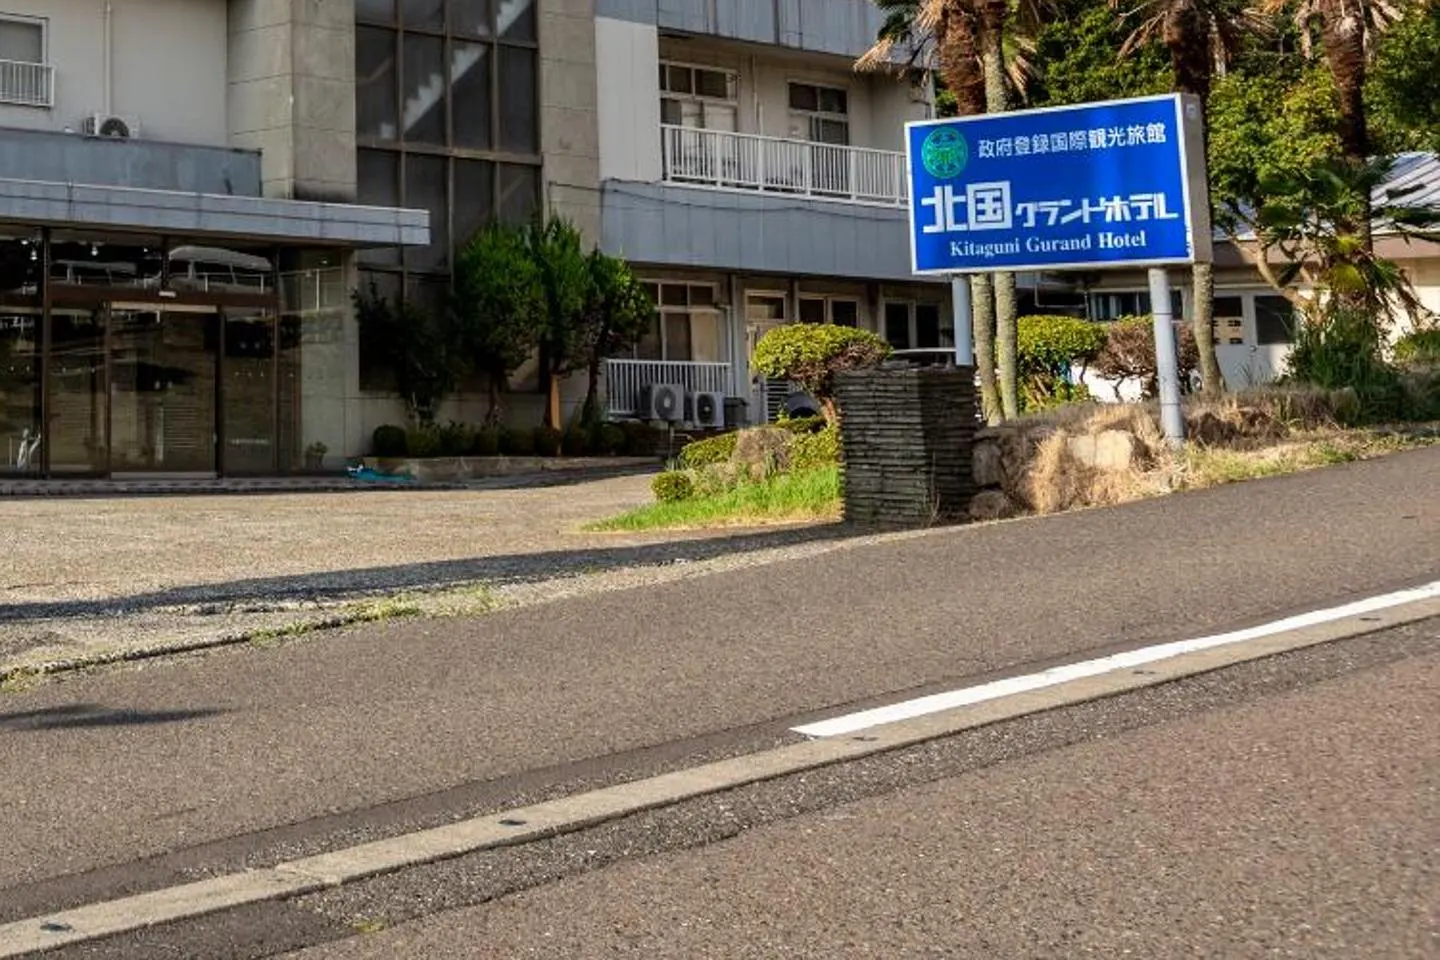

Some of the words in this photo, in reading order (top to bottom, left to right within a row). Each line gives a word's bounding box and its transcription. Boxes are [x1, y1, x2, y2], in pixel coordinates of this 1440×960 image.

[978, 122, 1166, 158] 政府登録国際観光旅館
[921, 181, 1178, 233] 北国グランドホテル
[950, 238, 1020, 257] Kitaguni
[1026, 234, 1091, 252] Gurand
[1098, 230, 1146, 248] Hotel
